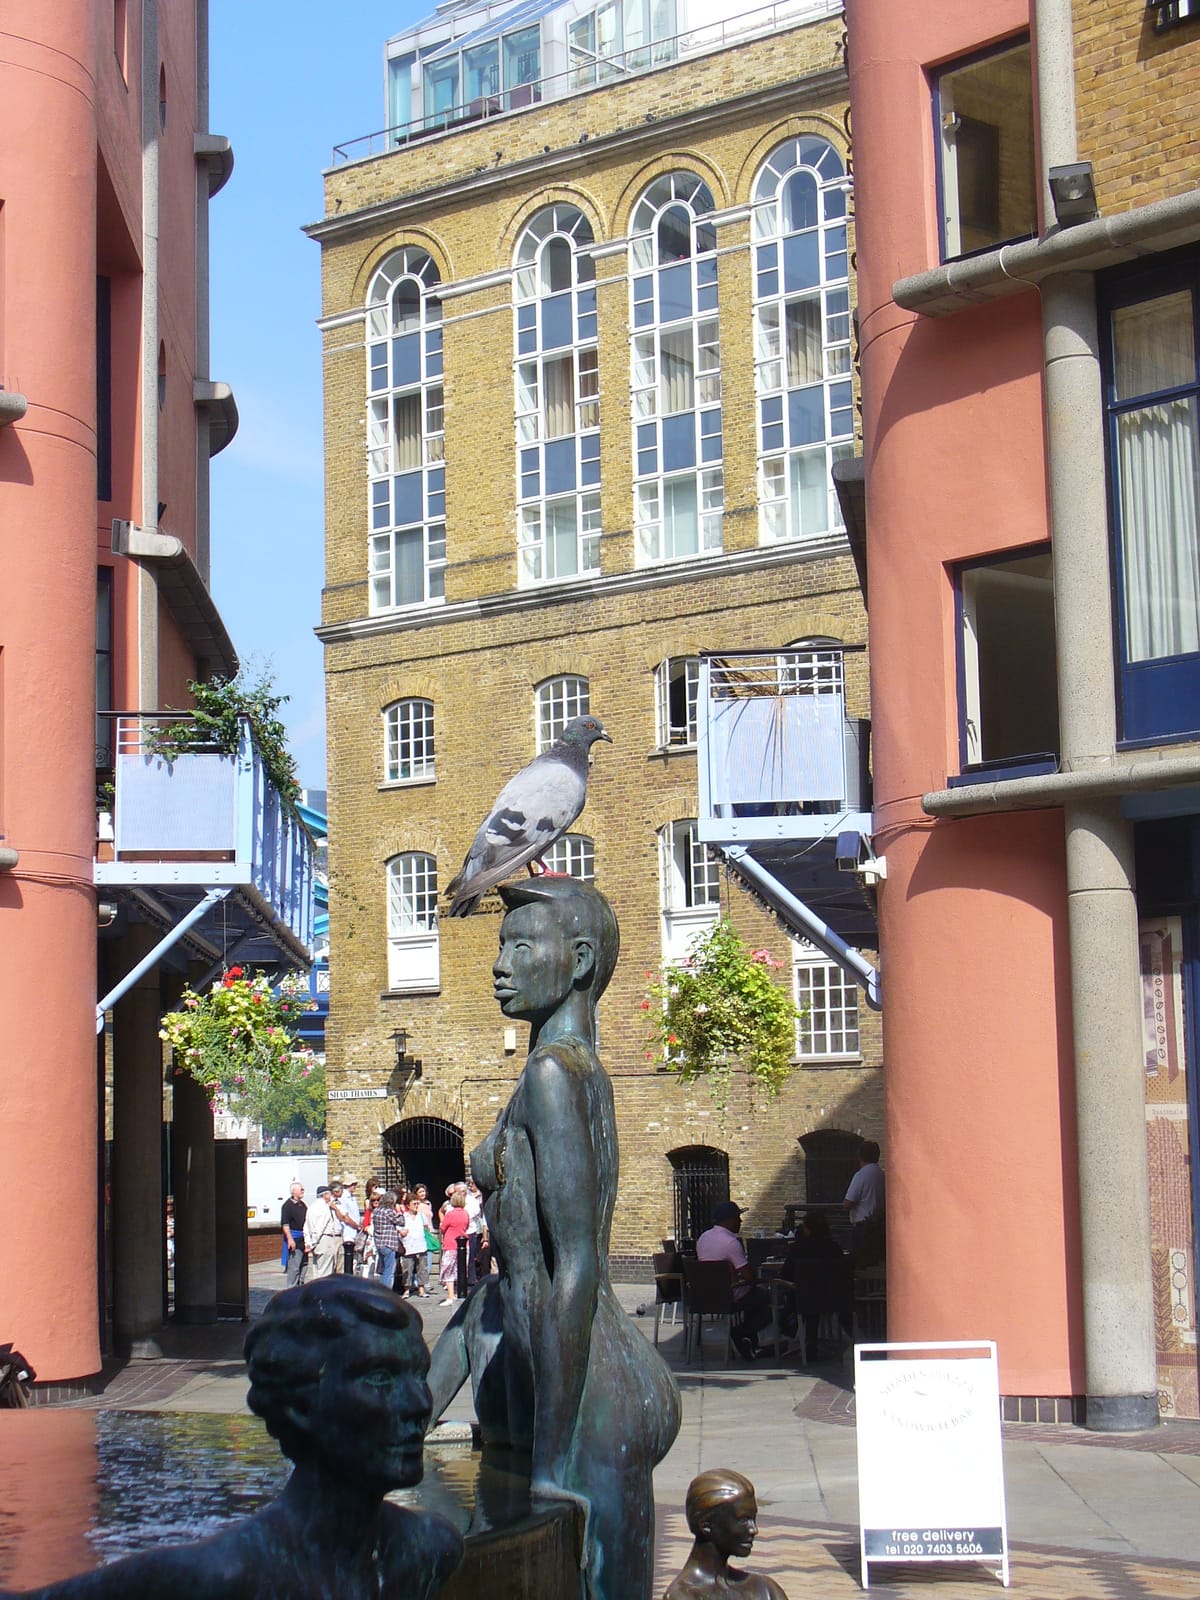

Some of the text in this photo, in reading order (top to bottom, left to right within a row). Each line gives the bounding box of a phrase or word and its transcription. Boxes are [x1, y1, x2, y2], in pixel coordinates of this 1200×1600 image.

[351, 1090, 378, 1098] THAMES
[891, 1530, 974, 1542] free delivery
[885, 1543, 983, 1554] tel 020 7403 5606
